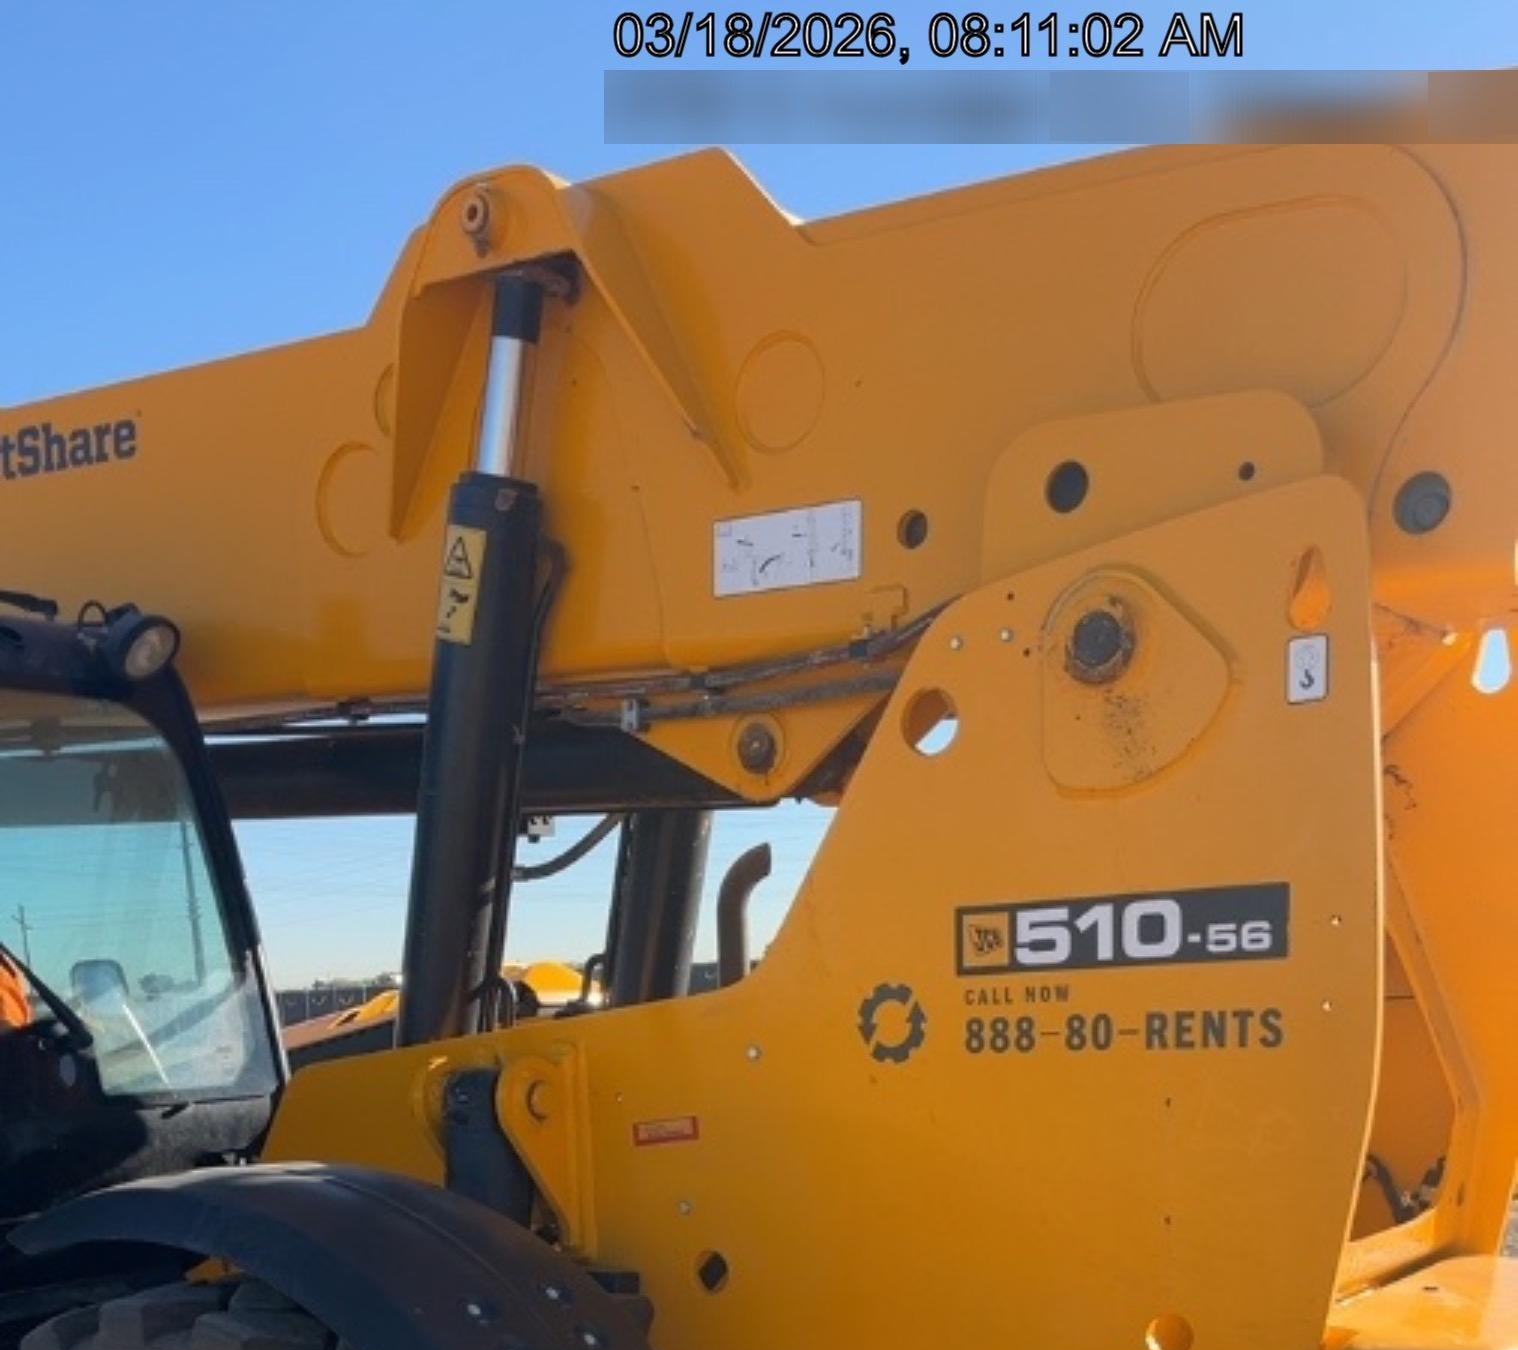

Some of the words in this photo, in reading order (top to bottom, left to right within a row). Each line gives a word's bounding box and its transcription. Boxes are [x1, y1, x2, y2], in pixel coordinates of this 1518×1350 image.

[1014, 898, 1273, 967] 510-56
[964, 986, 1013, 1006] CALL
[1025, 984, 1070, 1003] NOW
